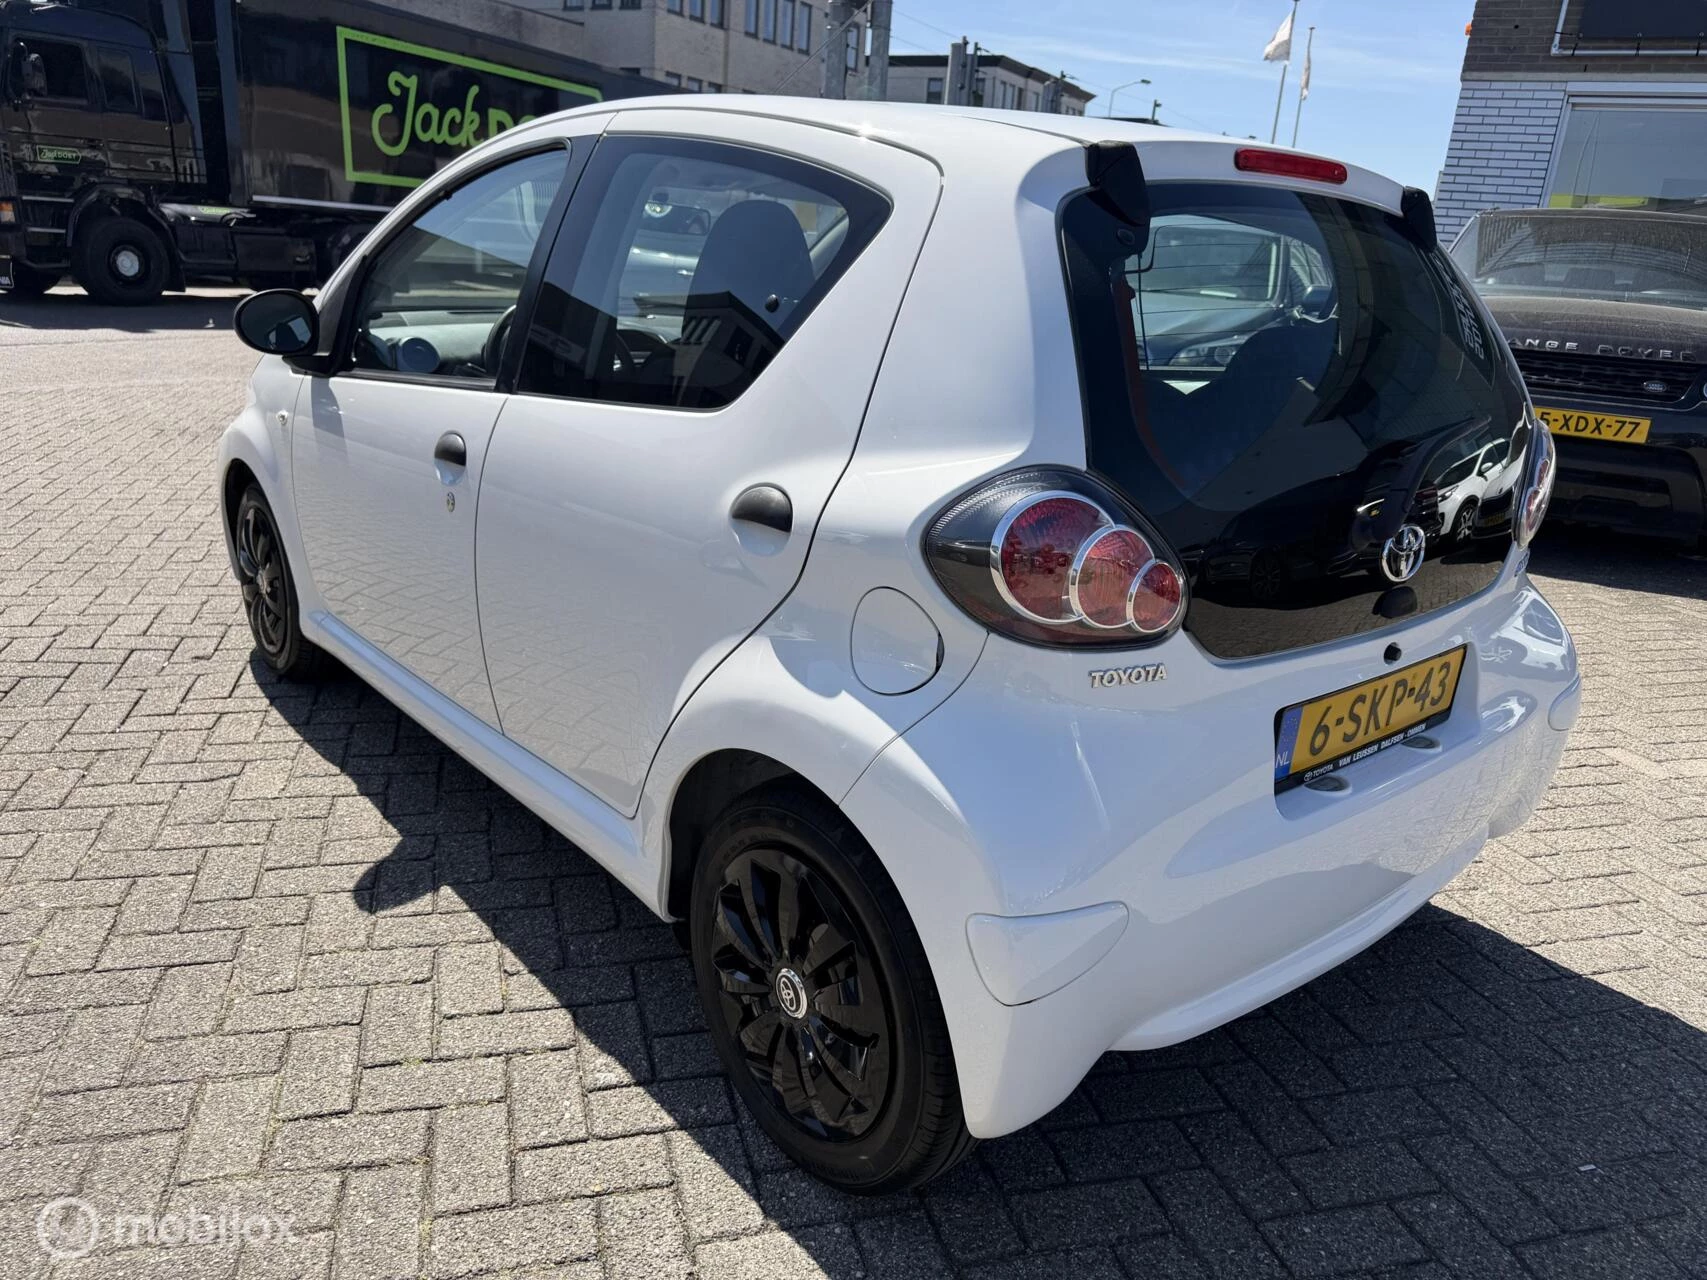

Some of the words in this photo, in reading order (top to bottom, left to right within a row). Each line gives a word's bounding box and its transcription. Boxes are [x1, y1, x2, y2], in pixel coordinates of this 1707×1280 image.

[372, 71, 484, 156] Jack
[1507, 338, 1579, 351] ANGE
[1540, 412, 1641, 438] 5-XDX-77
[1088, 663, 1167, 688] TOYOTA
[1309, 661, 1450, 756] 6-SKP-43
[1275, 751, 1290, 769] NL
[1313, 764, 1334, 777] TOYOTA
